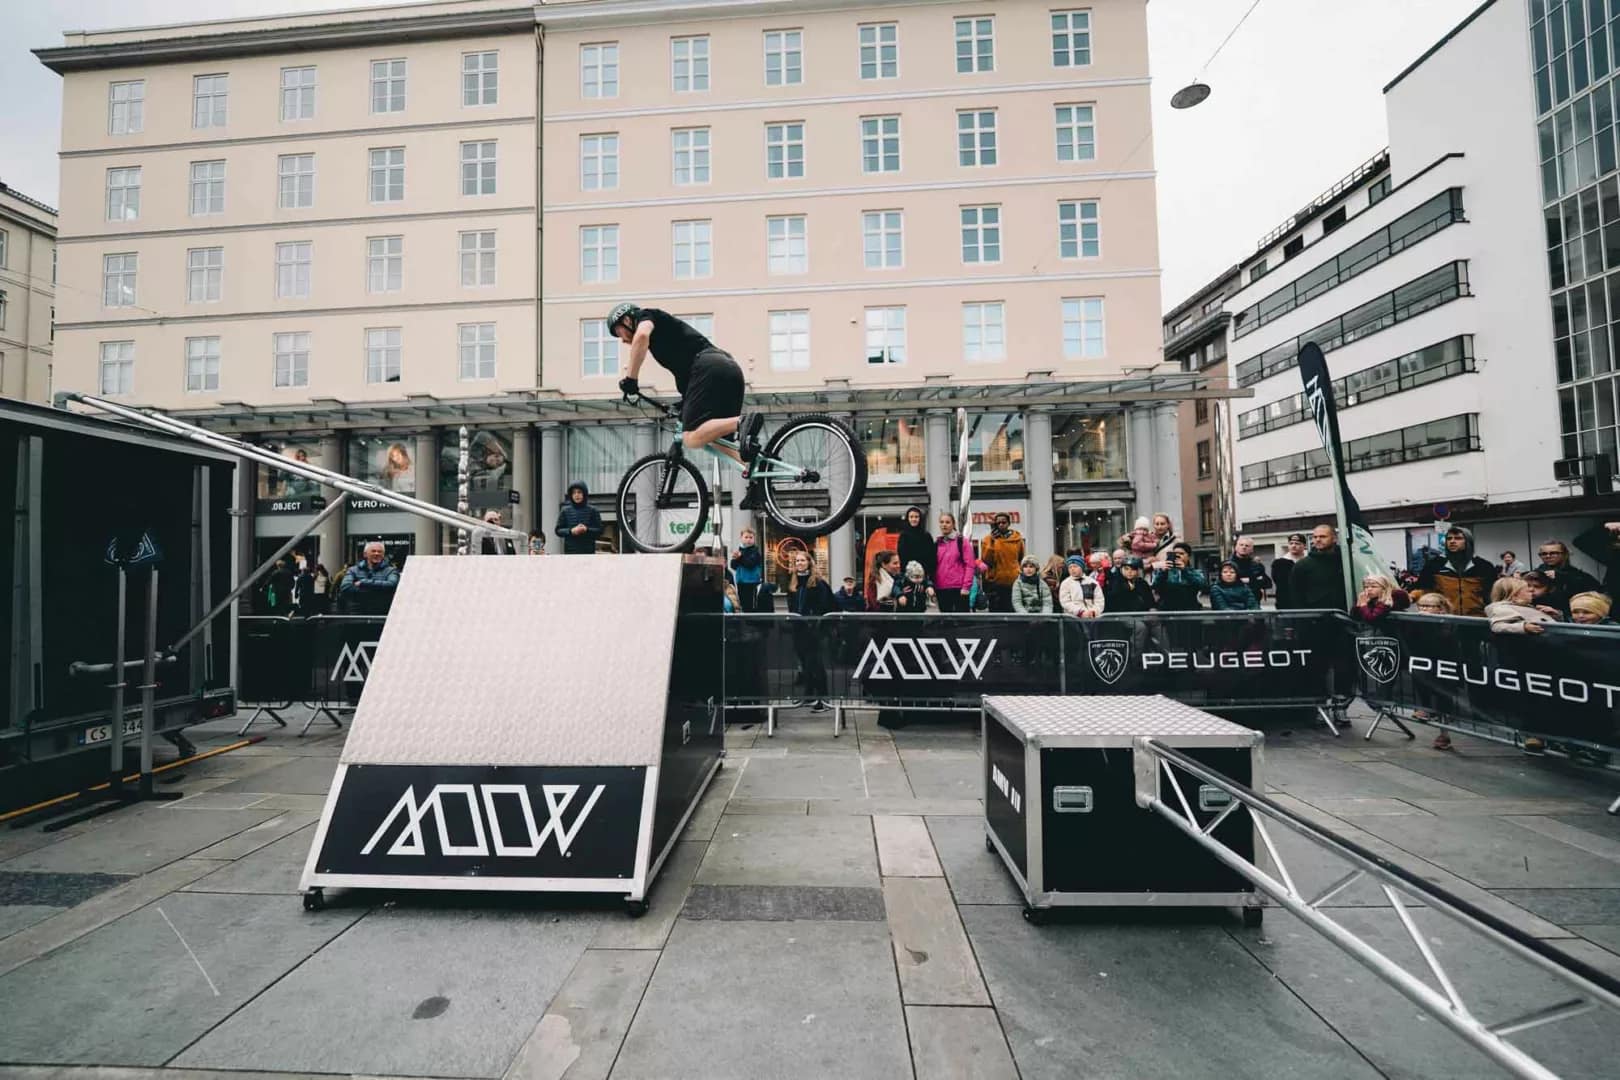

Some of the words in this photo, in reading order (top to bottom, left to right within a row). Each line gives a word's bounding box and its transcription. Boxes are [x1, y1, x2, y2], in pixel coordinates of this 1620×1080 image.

[351, 500, 378, 509] VERO
[1141, 649, 1313, 670] PEUGEOT
[1407, 655, 1620, 710] PEUGEOT
[90, 727, 107, 741] CS
